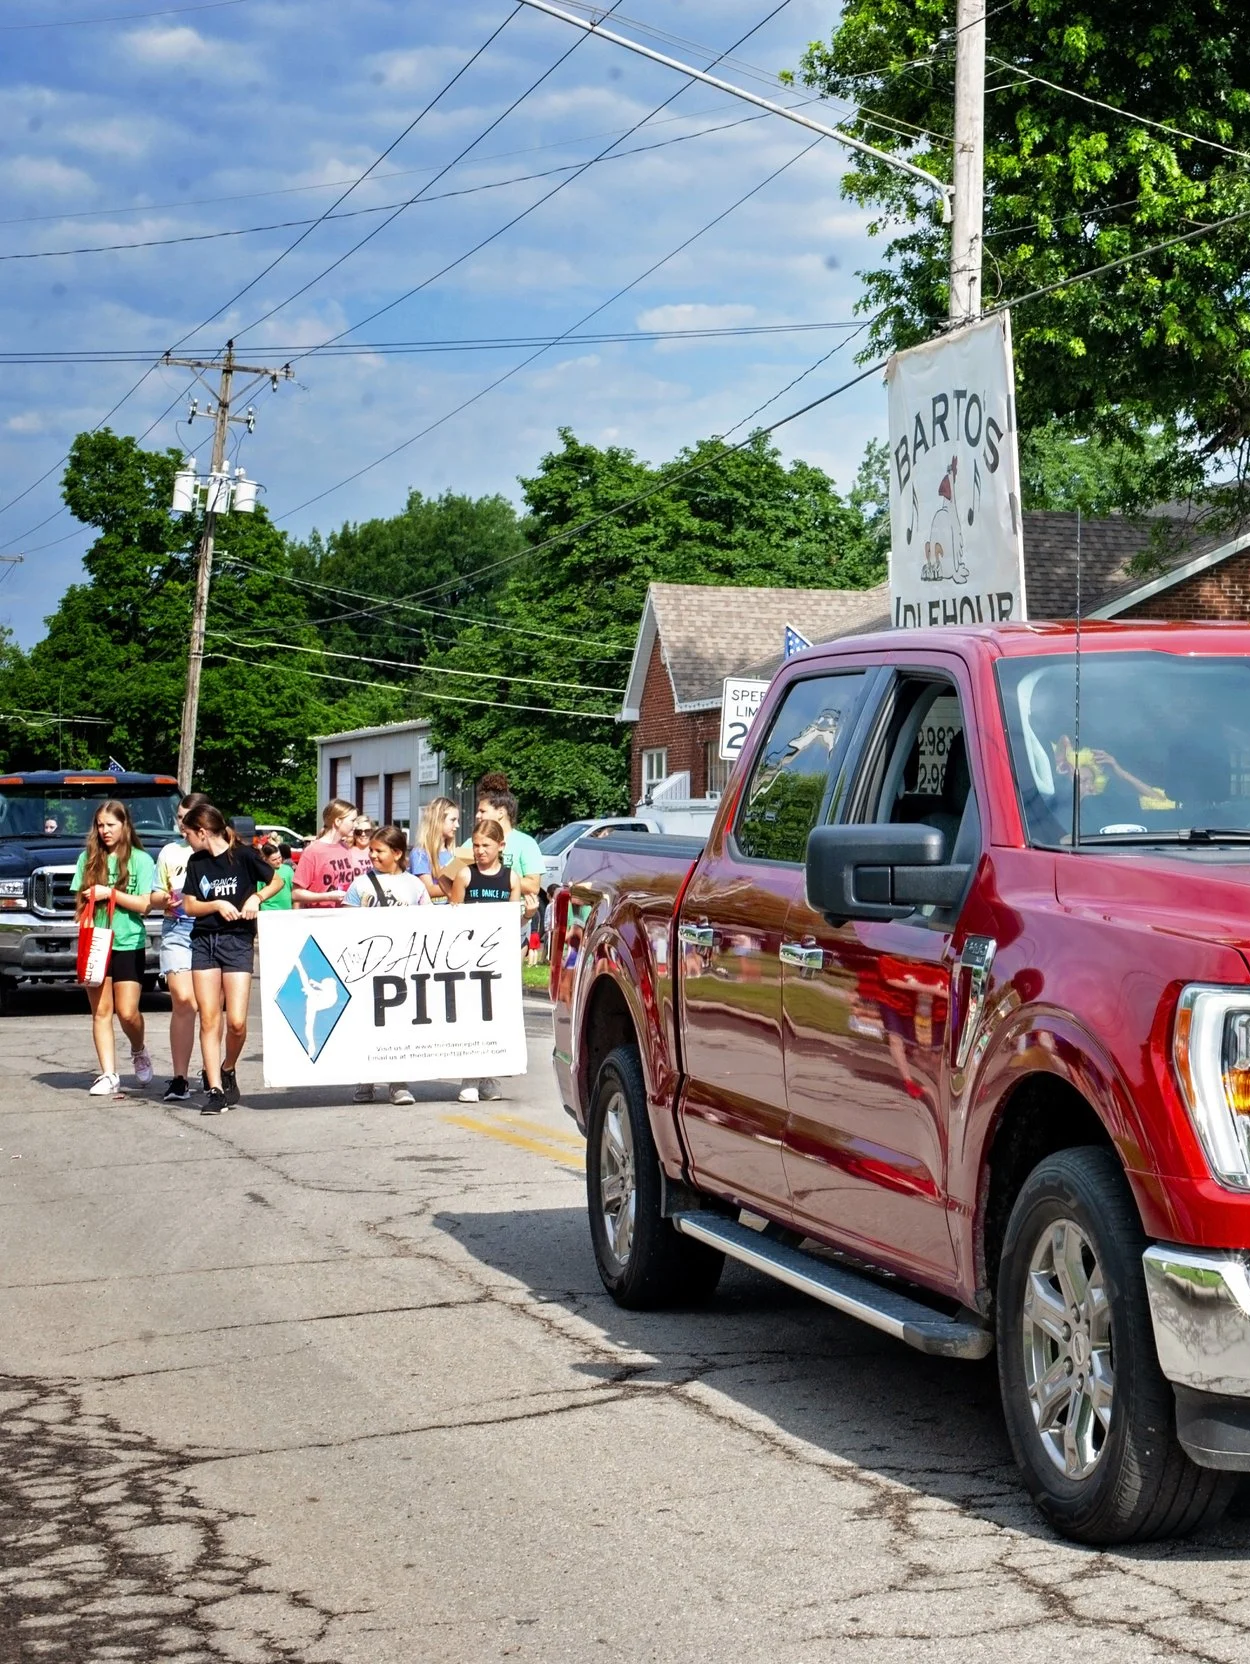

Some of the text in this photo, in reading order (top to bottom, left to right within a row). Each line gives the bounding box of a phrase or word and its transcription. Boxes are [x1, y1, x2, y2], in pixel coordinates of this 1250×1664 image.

[894, 389, 1003, 496] BARTO'S
[731, 689, 767, 702] SPEE
[736, 705, 759, 718] LIM
[726, 722, 748, 750] 2
[329, 858, 351, 871] THE
[214, 884, 238, 897] PITT
[469, 889, 479, 898] THE
[481, 889, 499, 898] DANCE
[345, 927, 502, 983] DANCE
[372, 970, 502, 1027] PITT
